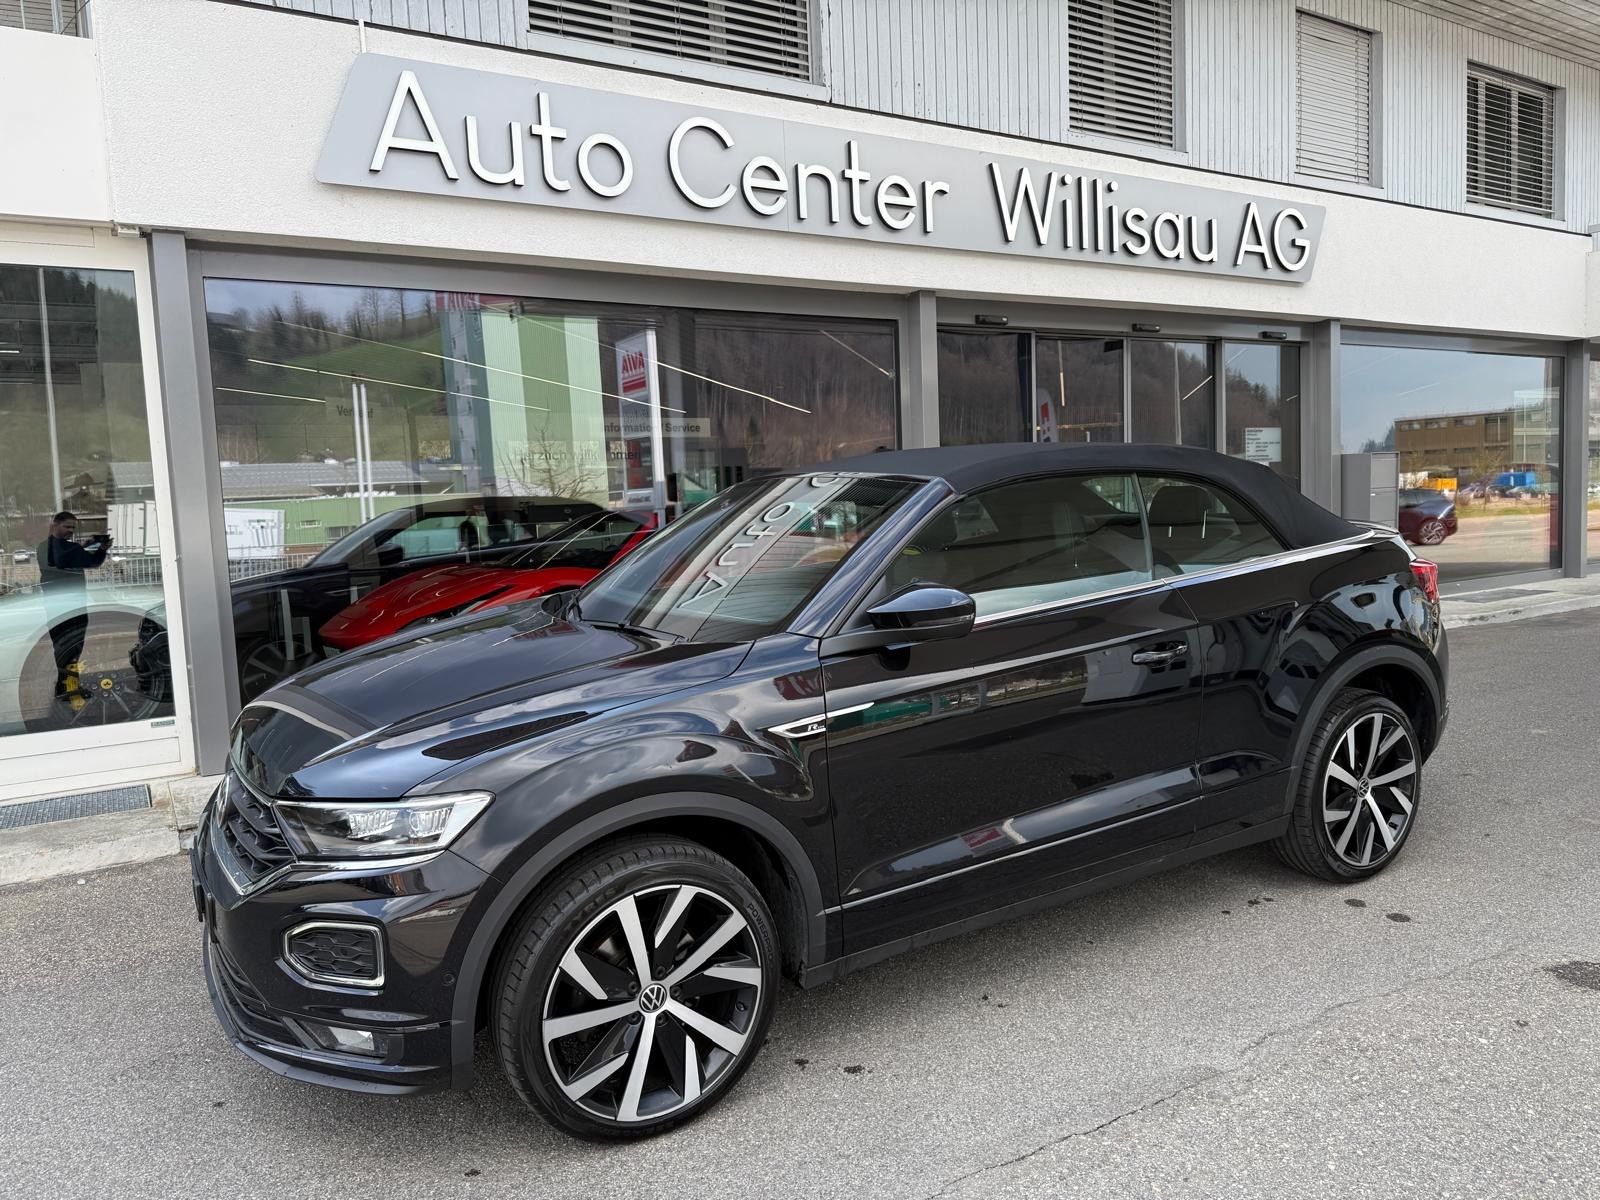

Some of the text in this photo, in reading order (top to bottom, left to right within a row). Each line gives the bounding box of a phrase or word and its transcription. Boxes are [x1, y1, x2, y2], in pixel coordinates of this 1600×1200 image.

[369, 70, 1311, 272] Auto Center Willisau AG
[665, 422, 701, 433] Service
